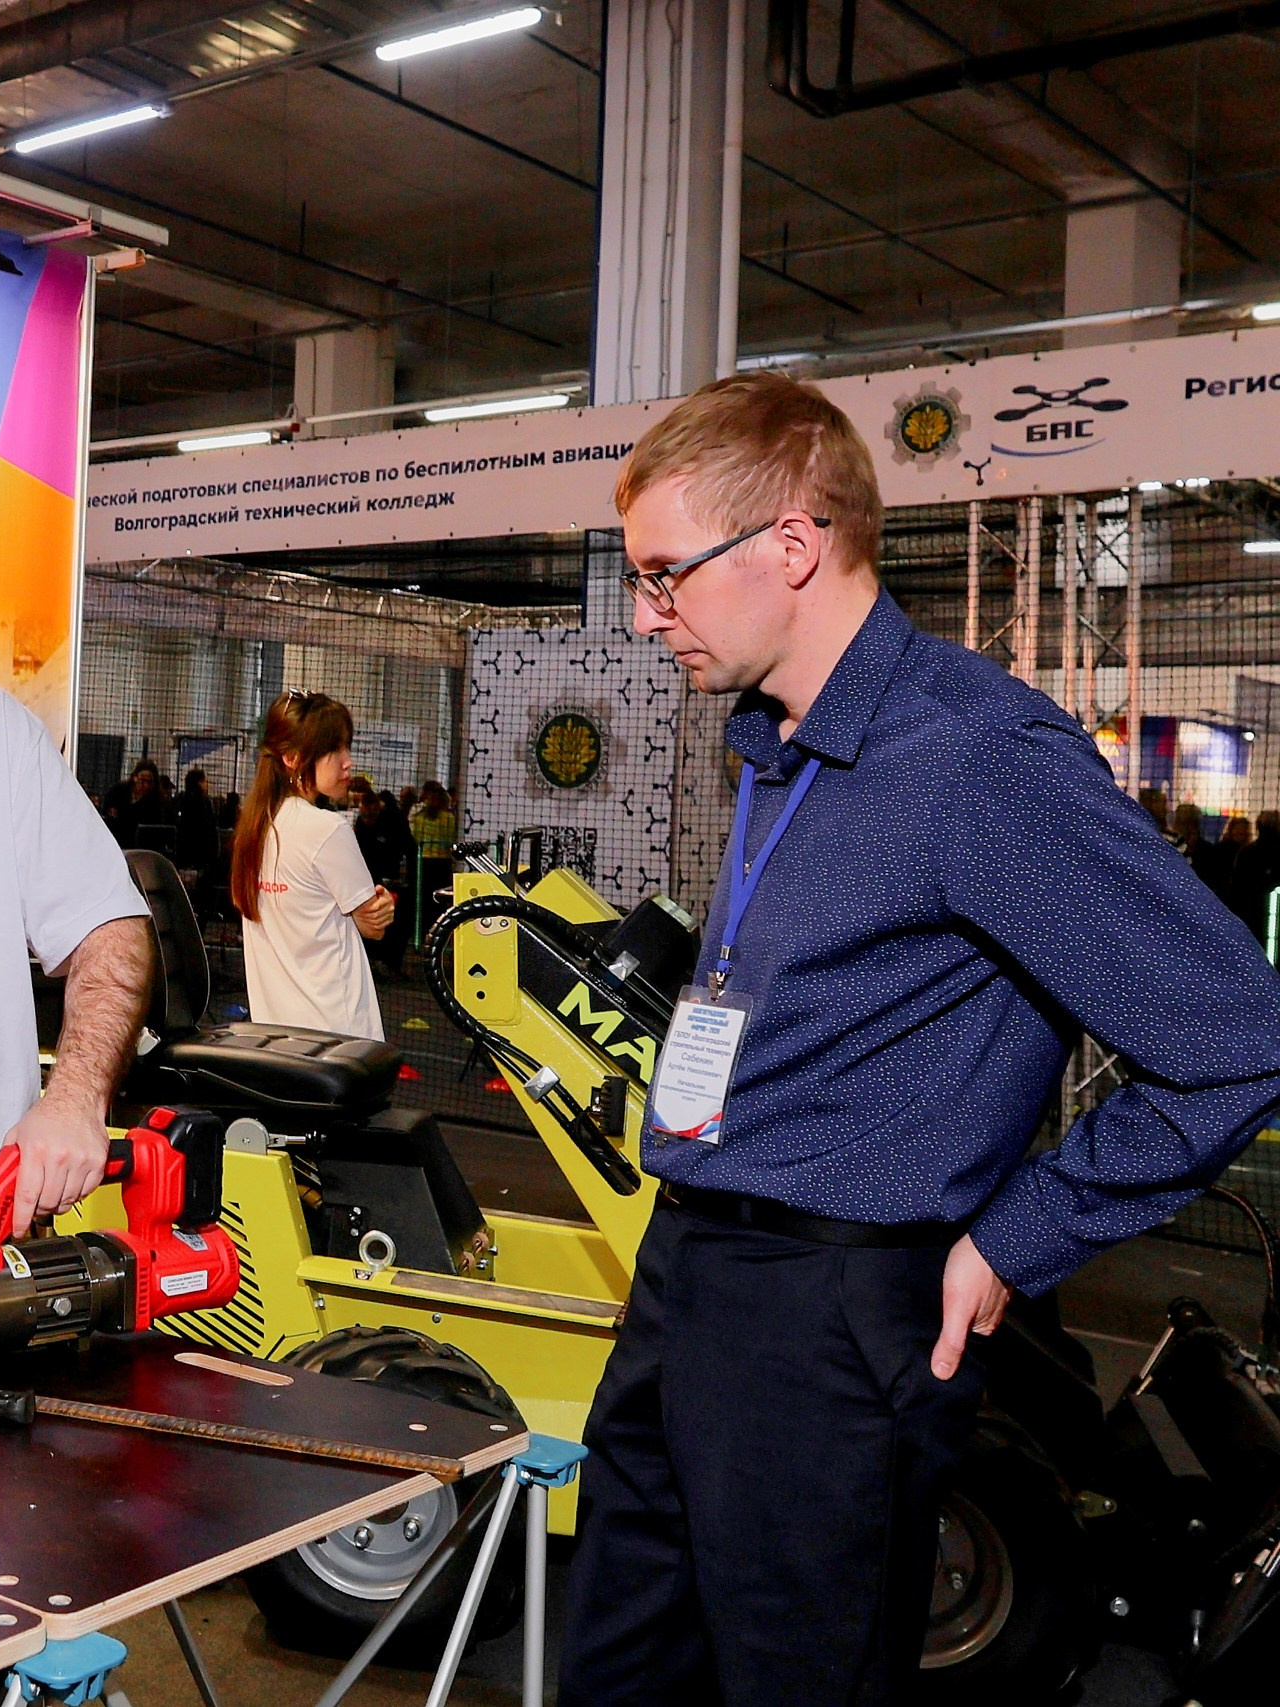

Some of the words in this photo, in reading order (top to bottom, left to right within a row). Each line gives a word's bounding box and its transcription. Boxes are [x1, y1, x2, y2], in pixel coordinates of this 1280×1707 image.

[1184, 374, 1280, 399] Регио
[1026, 419, 1094, 442] БАС
[142, 481, 237, 504] подготовки
[242, 469, 370, 494] специалистов
[376, 466, 399, 482] по
[404, 452, 546, 478] беспилотным
[114, 506, 239, 532] Волгоградский
[245, 496, 360, 522] технический
[366, 491, 455, 512] колледж
